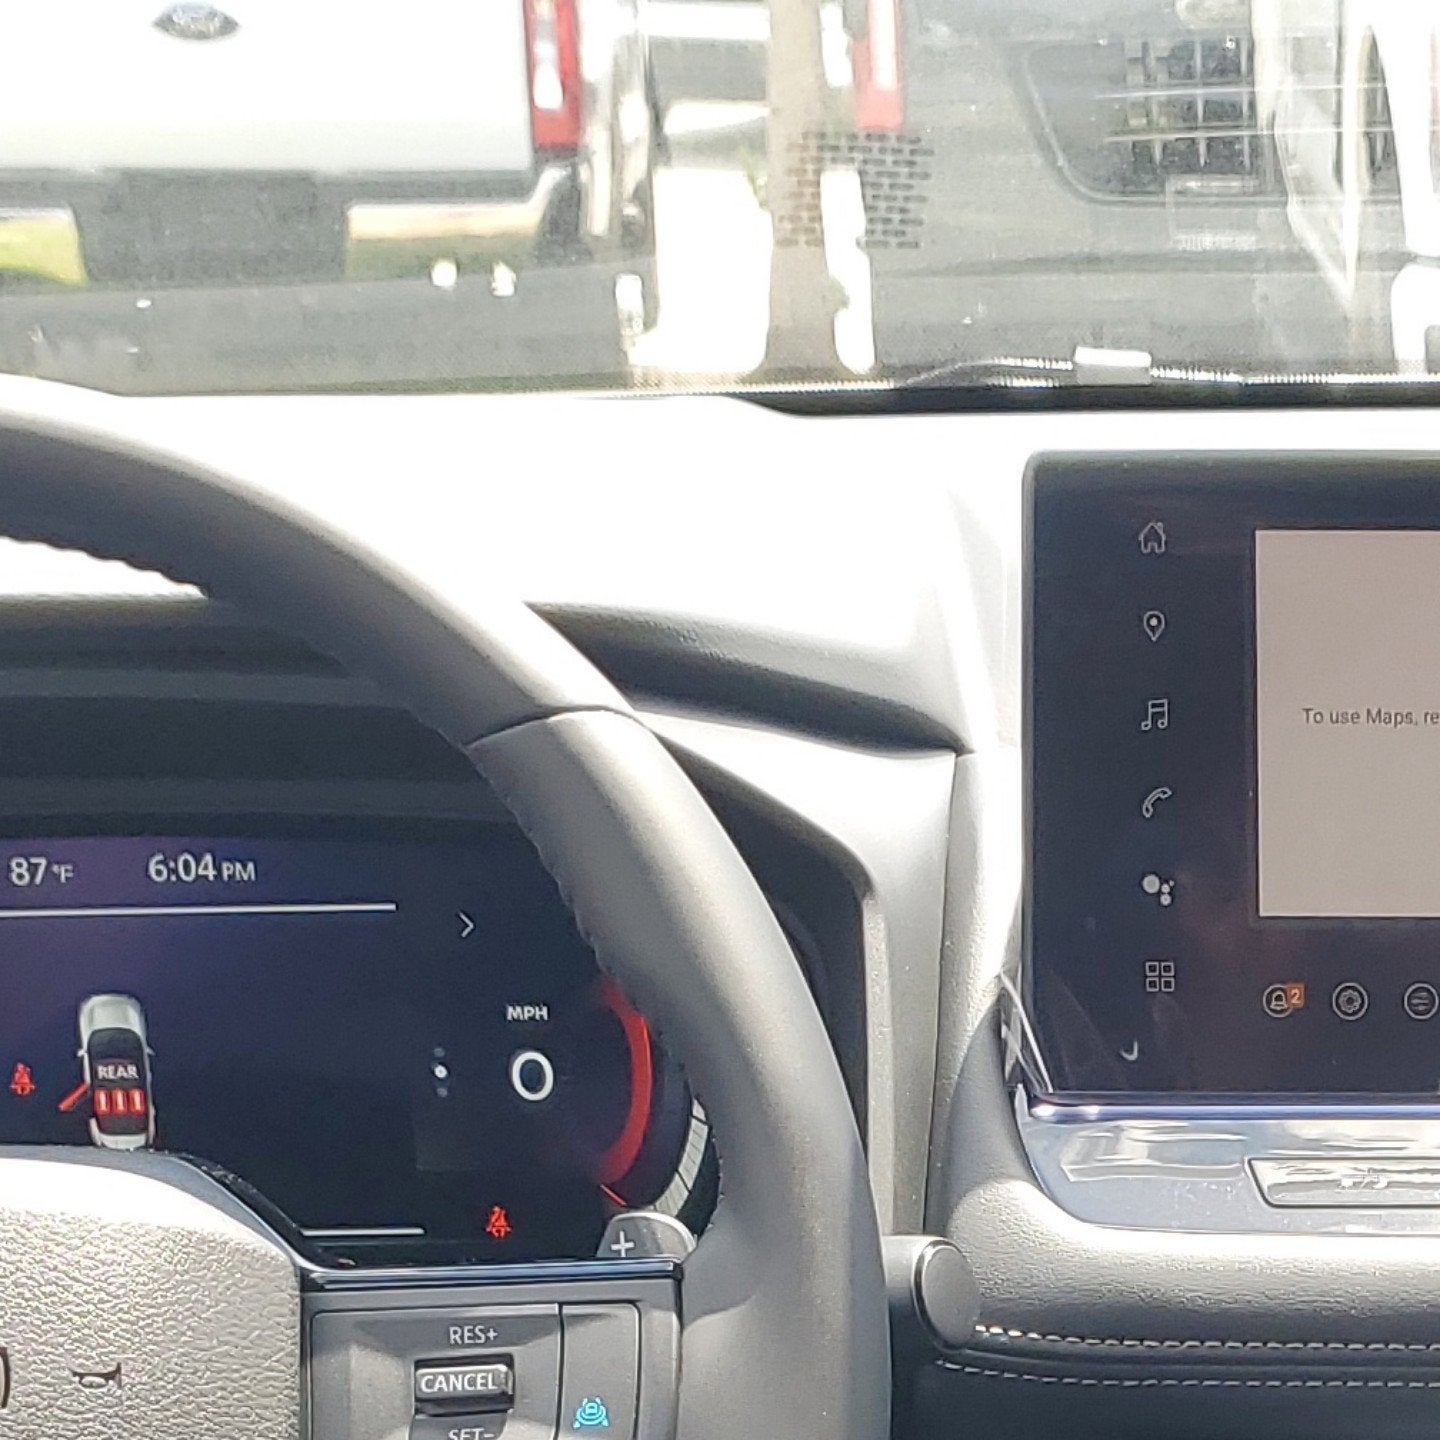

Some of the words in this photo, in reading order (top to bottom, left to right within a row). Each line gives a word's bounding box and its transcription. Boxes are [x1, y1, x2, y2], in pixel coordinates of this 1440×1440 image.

[1303, 708, 1324, 726] To
[1329, 711, 1359, 726] use
[1365, 708, 1418, 728] Maps,
[148, 853, 217, 883] 6:04
[222, 860, 255, 883] PM
[506, 1004, 549, 1022] MPH
[97, 1064, 139, 1080] REAR
[510, 1049, 554, 1102] 0
[449, 1326, 498, 1345] RES+
[420, 1372, 498, 1393] CANCEL
